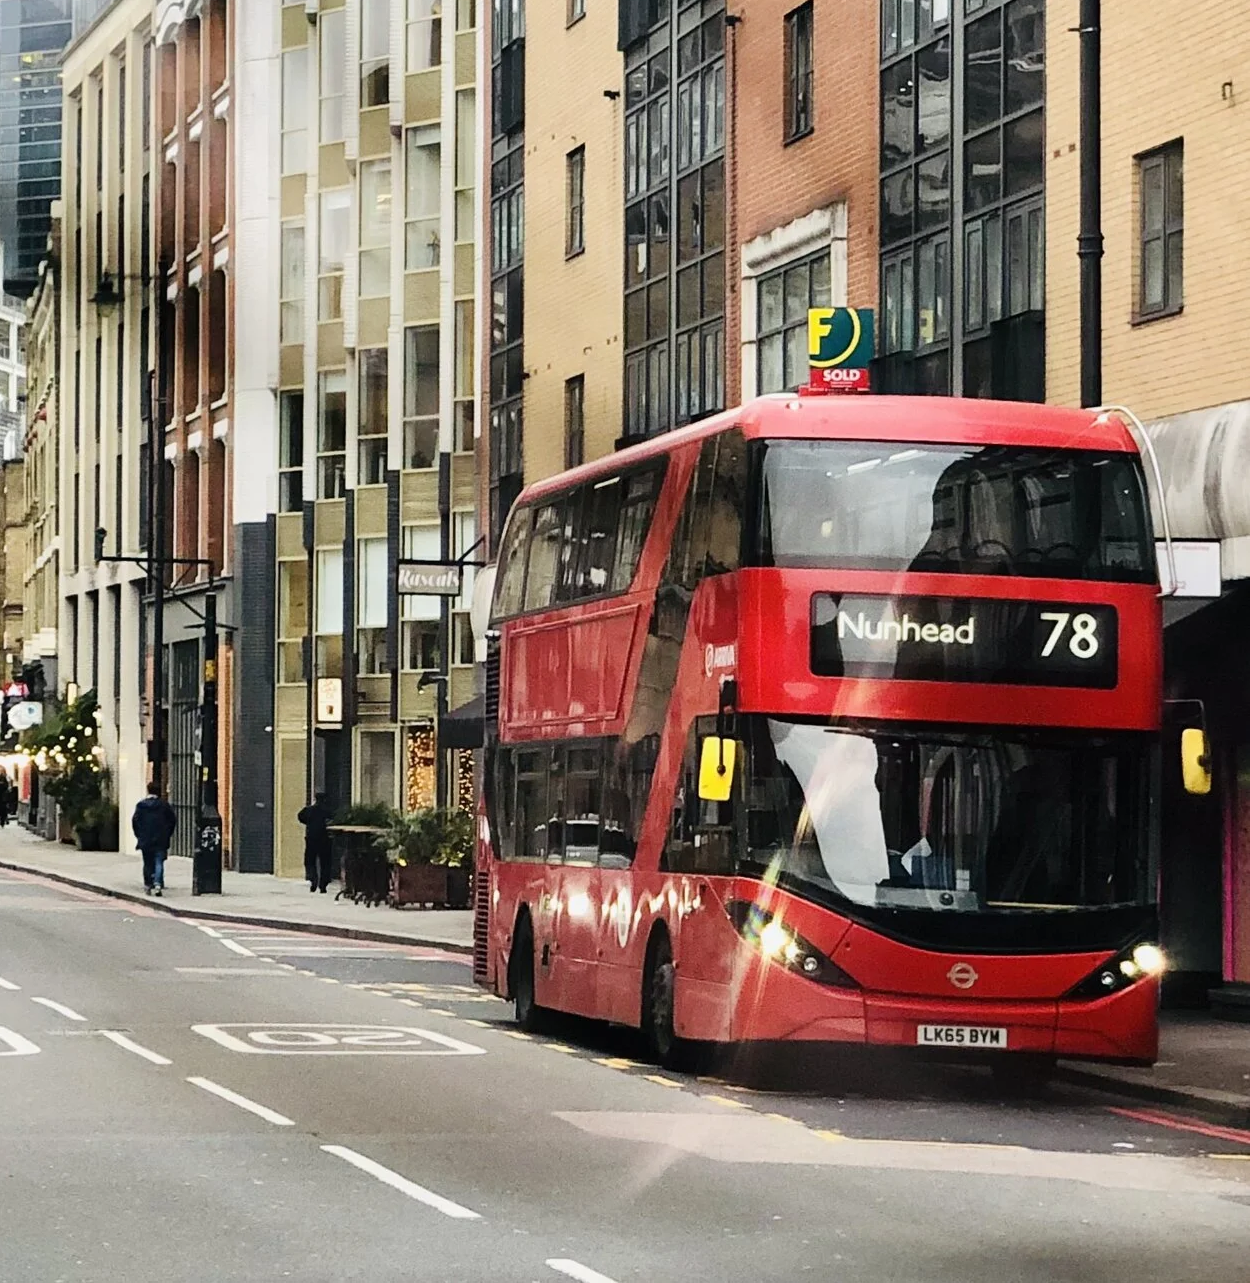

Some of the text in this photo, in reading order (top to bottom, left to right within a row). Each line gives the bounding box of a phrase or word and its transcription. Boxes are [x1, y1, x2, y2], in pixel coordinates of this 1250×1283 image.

[823, 369, 860, 382] SOLD
[838, 611, 1099, 659] Nunhead 78
[924, 1027, 1000, 1044] LK65 BYM
